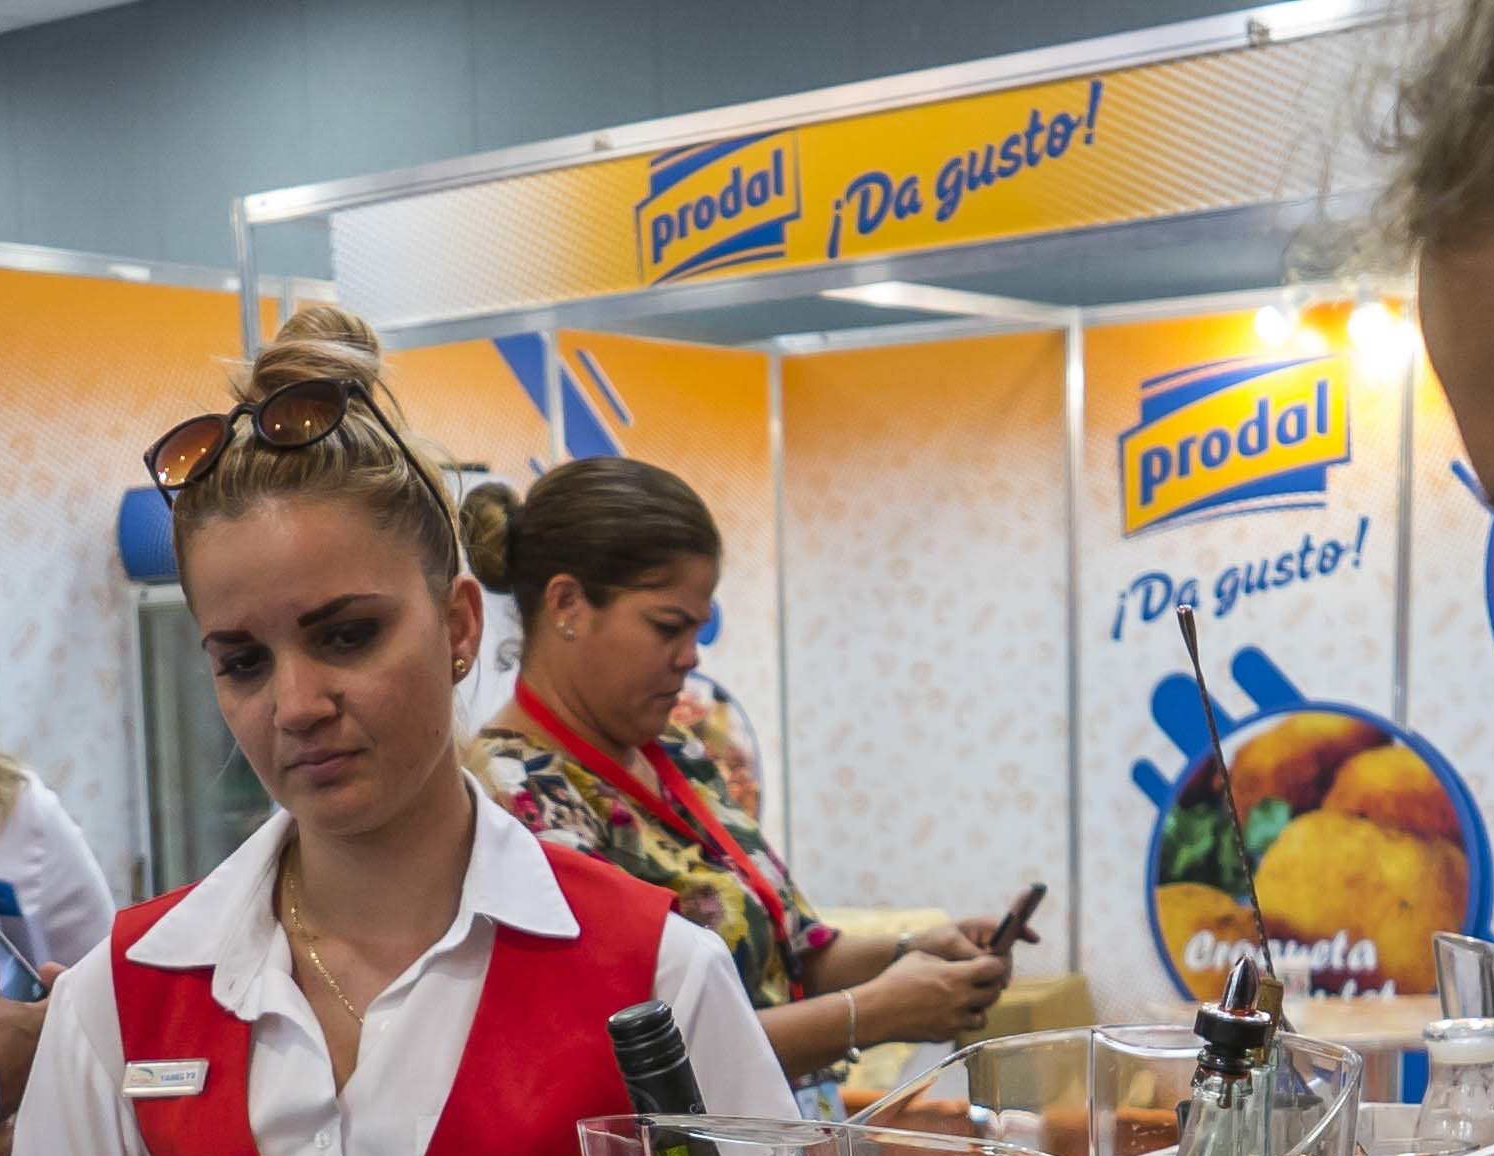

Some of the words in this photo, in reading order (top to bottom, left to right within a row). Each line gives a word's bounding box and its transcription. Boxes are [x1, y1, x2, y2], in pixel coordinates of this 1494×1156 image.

[651, 148, 785, 264] prodal
[827, 171, 922, 258] ¡Da
[935, 80, 1102, 221] gusto!
[1139, 379, 1328, 507] prodal
[1111, 569, 1200, 641] ¡Da
[1214, 516, 1370, 618] gusto!
